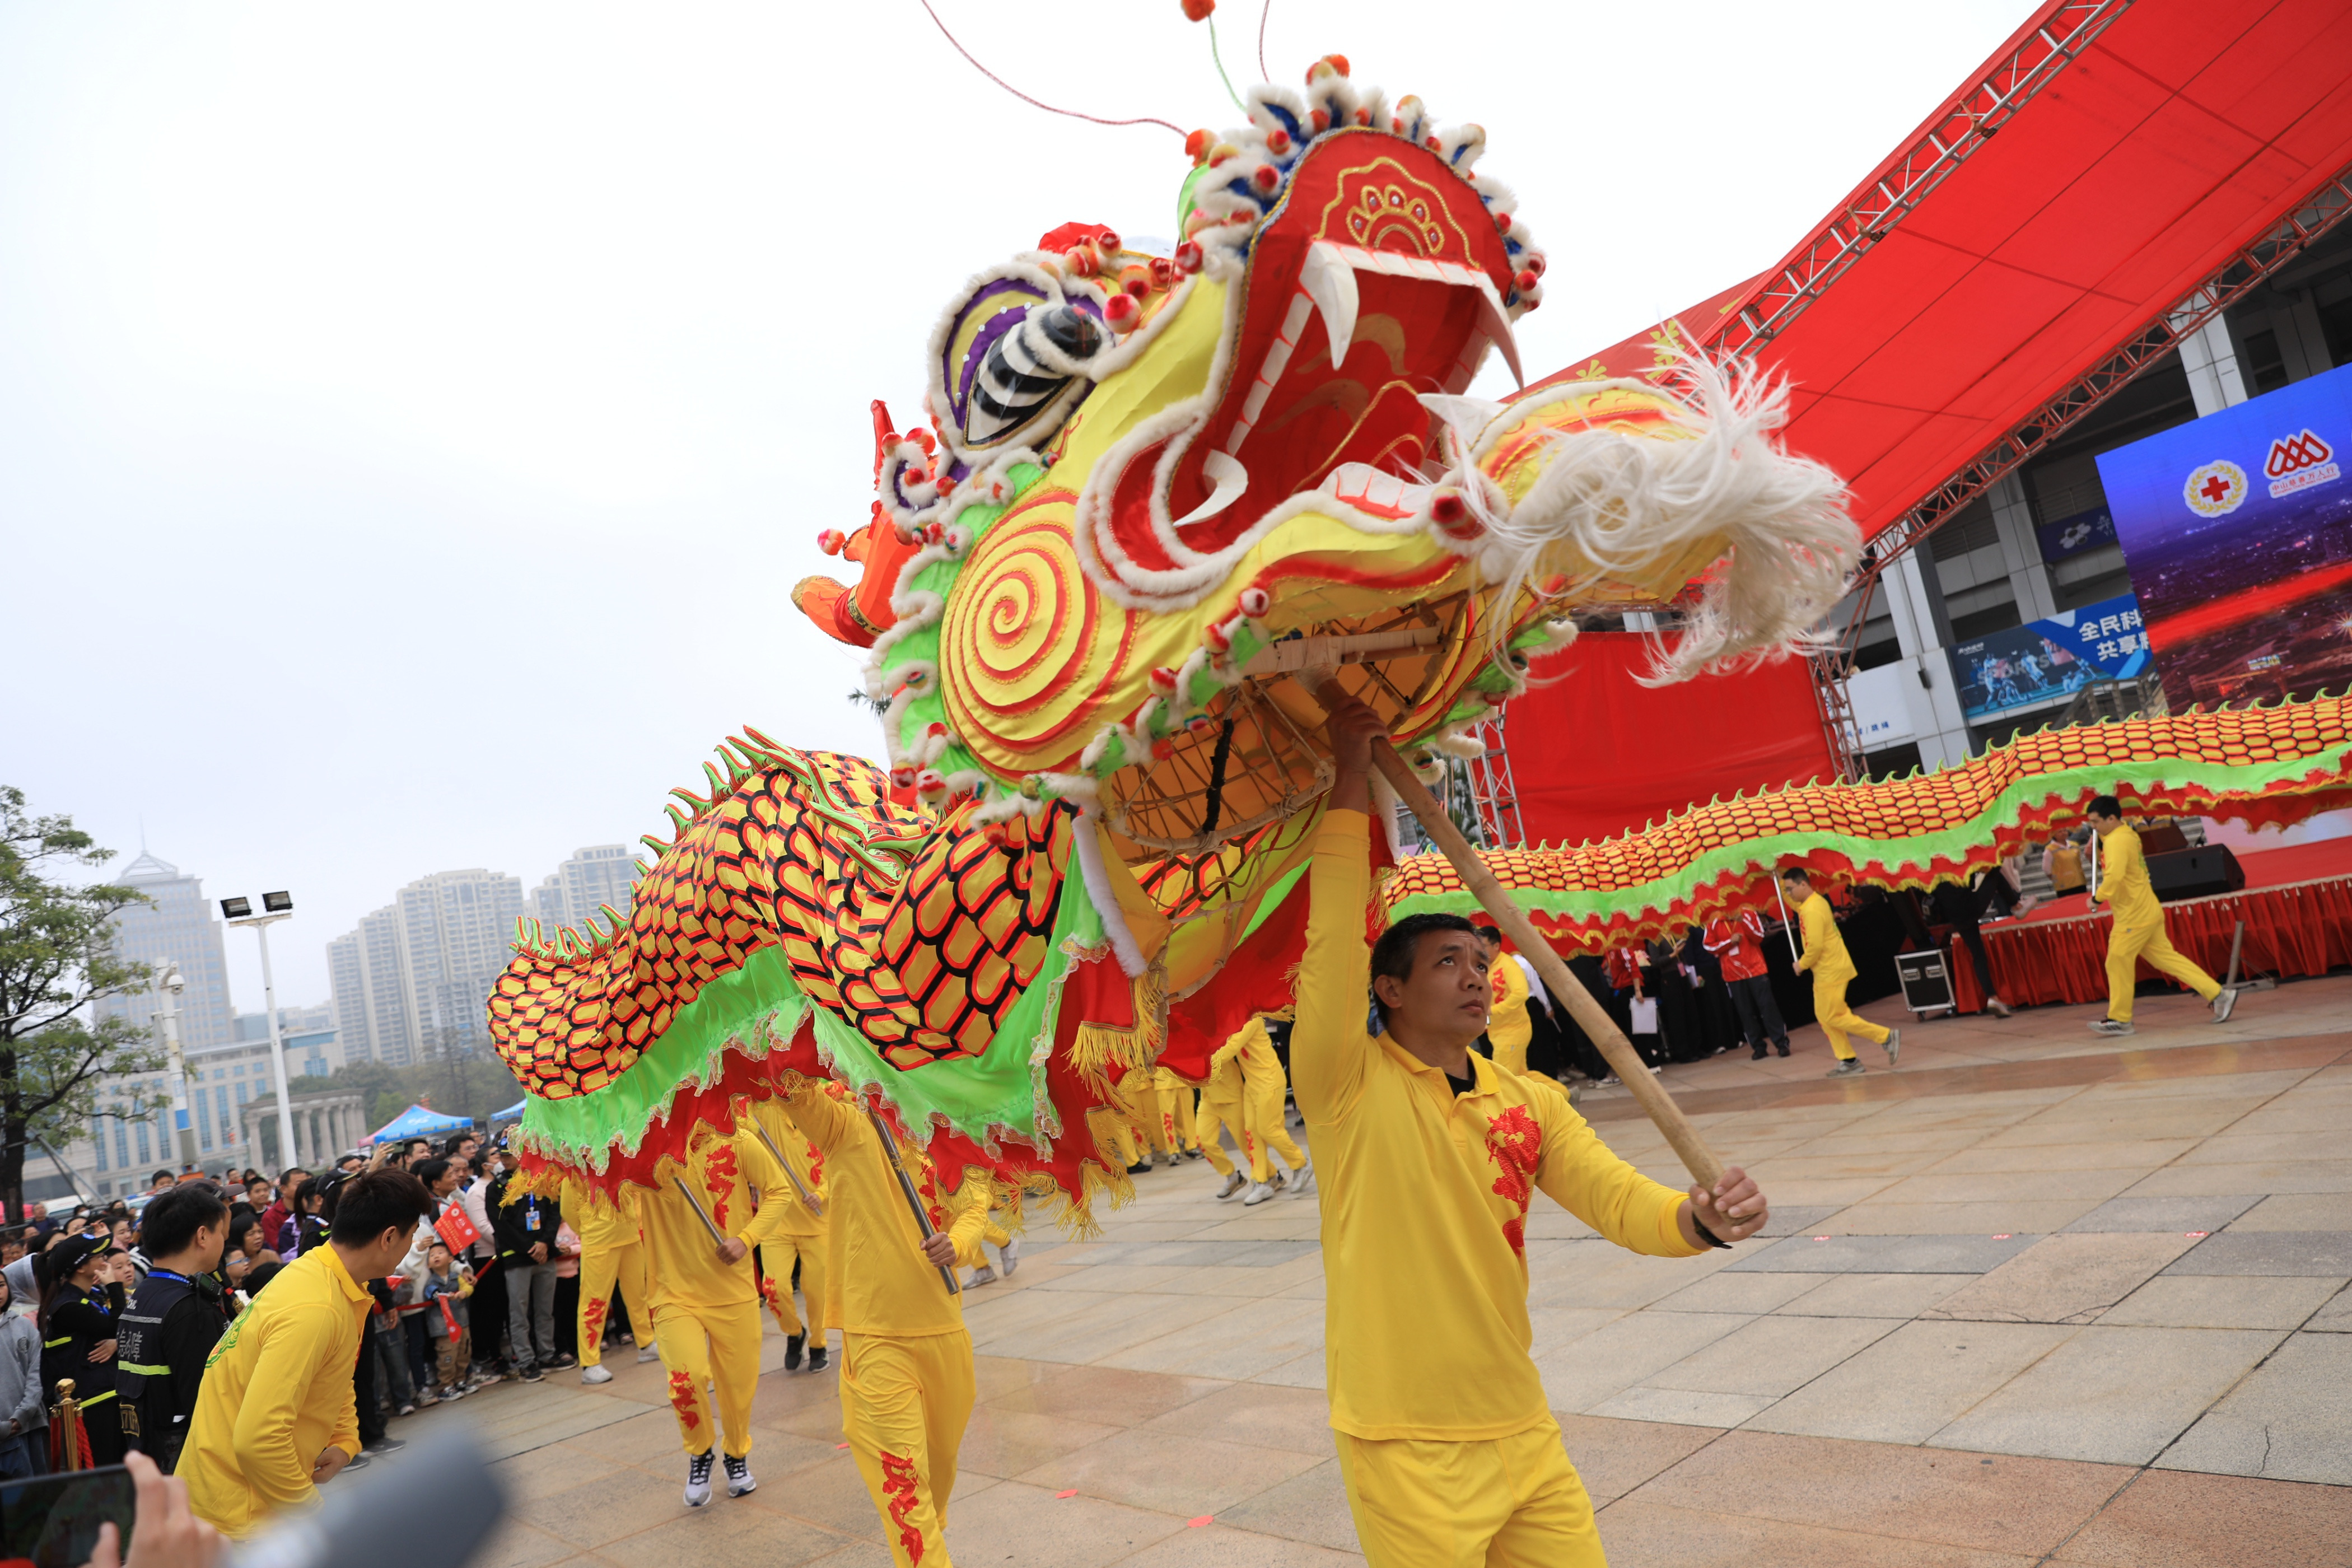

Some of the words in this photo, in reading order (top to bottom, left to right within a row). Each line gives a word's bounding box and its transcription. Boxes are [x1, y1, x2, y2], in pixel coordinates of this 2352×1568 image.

[2272, 466, 2335, 491] 中山慈善万人行
